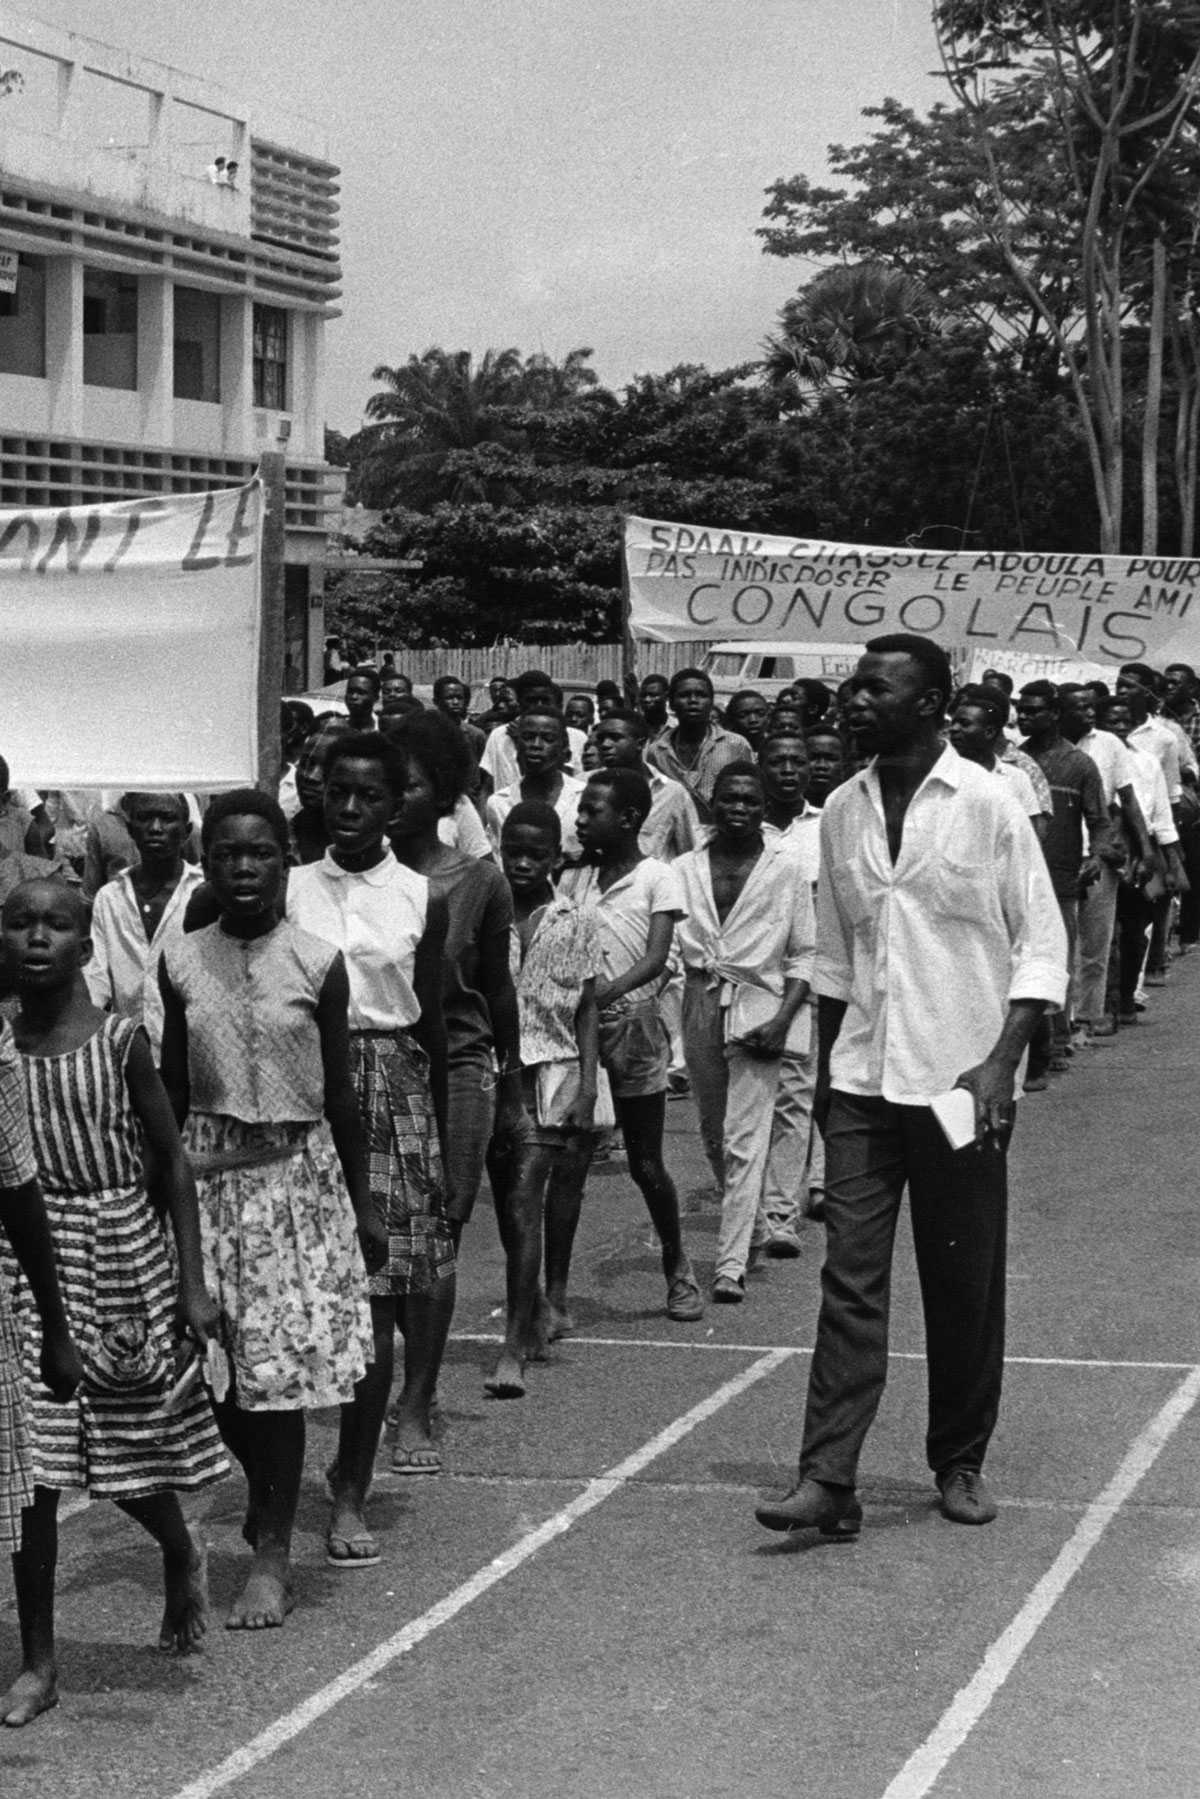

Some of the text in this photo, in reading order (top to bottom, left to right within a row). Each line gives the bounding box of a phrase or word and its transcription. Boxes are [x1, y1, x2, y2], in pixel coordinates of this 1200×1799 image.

[181, 480, 259, 570] LE
[646, 552, 1194, 618] PAS INDISPOSER LE PEUPLE AMI
[972, 552, 1105, 578] ADOULA
[1126, 559, 1200, 588] POUR
[687, 583, 1153, 661] CONGOLAIS
